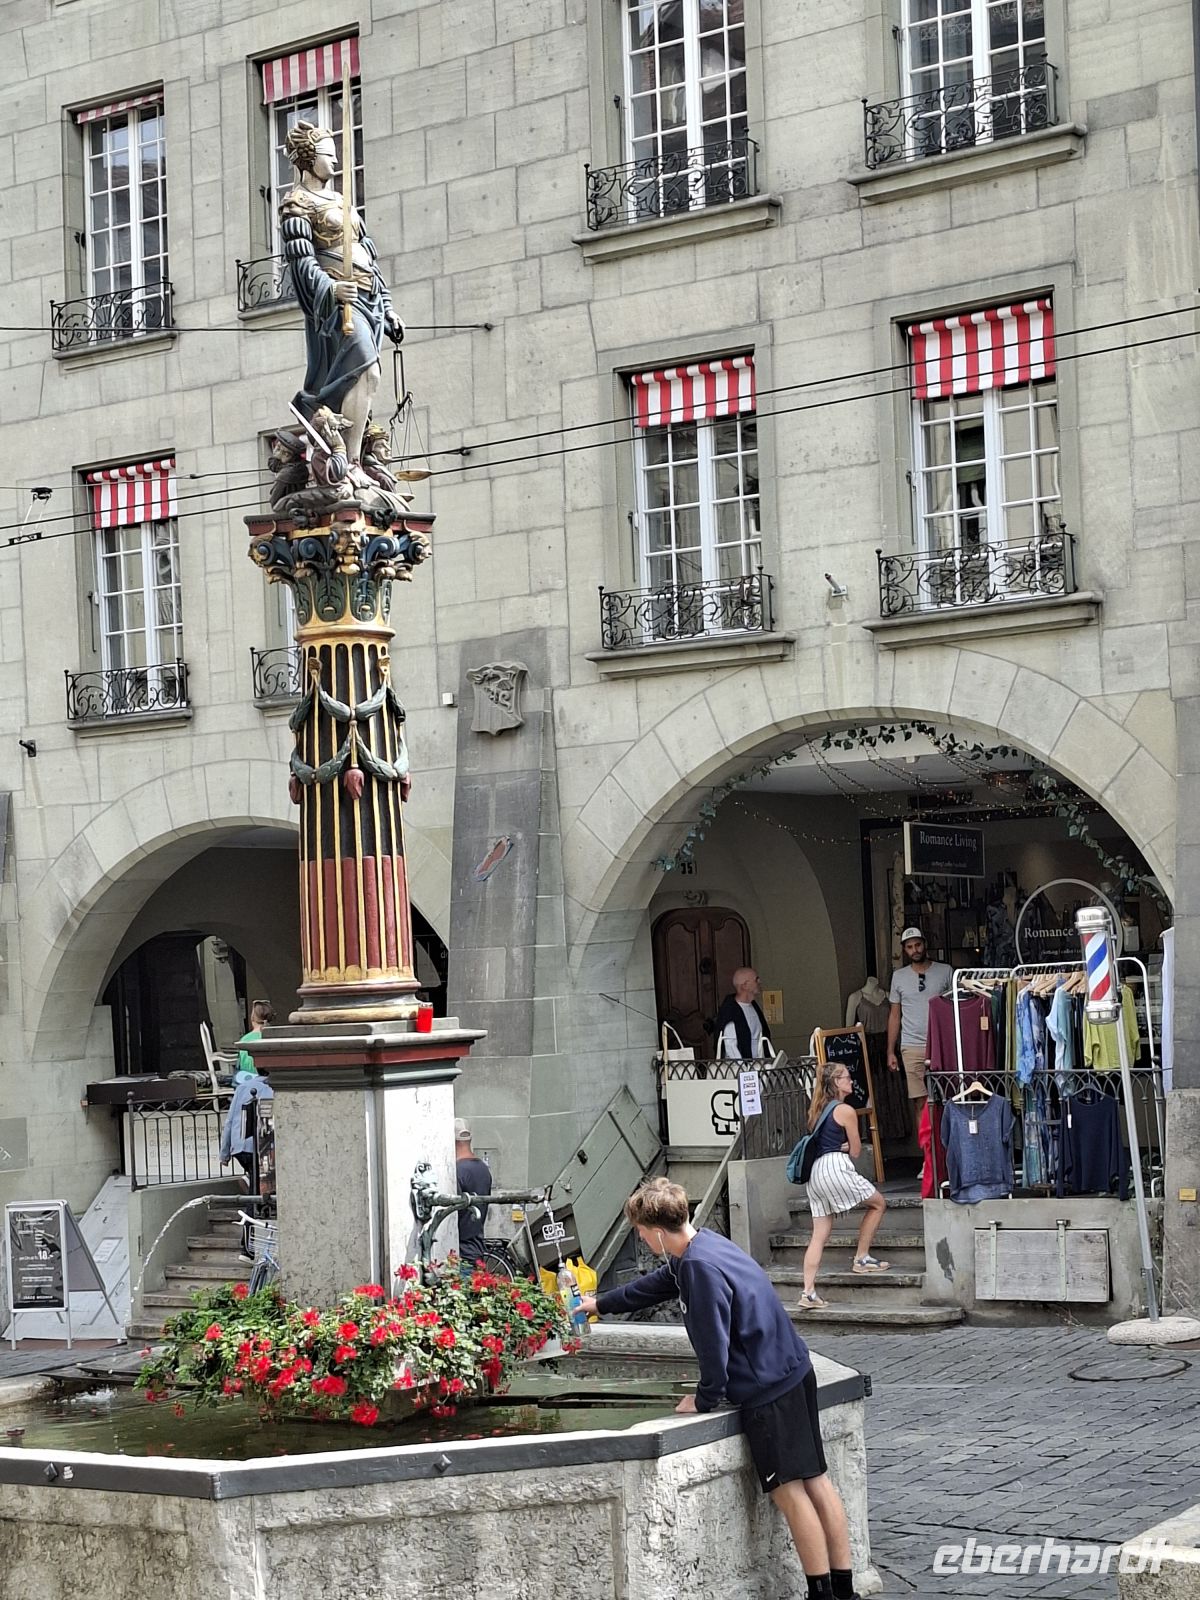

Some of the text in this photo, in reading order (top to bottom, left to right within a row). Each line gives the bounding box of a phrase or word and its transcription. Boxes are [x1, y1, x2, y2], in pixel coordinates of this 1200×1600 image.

[920, 831, 977, 852] Romance Living
[1024, 927, 1073, 938] Romance
